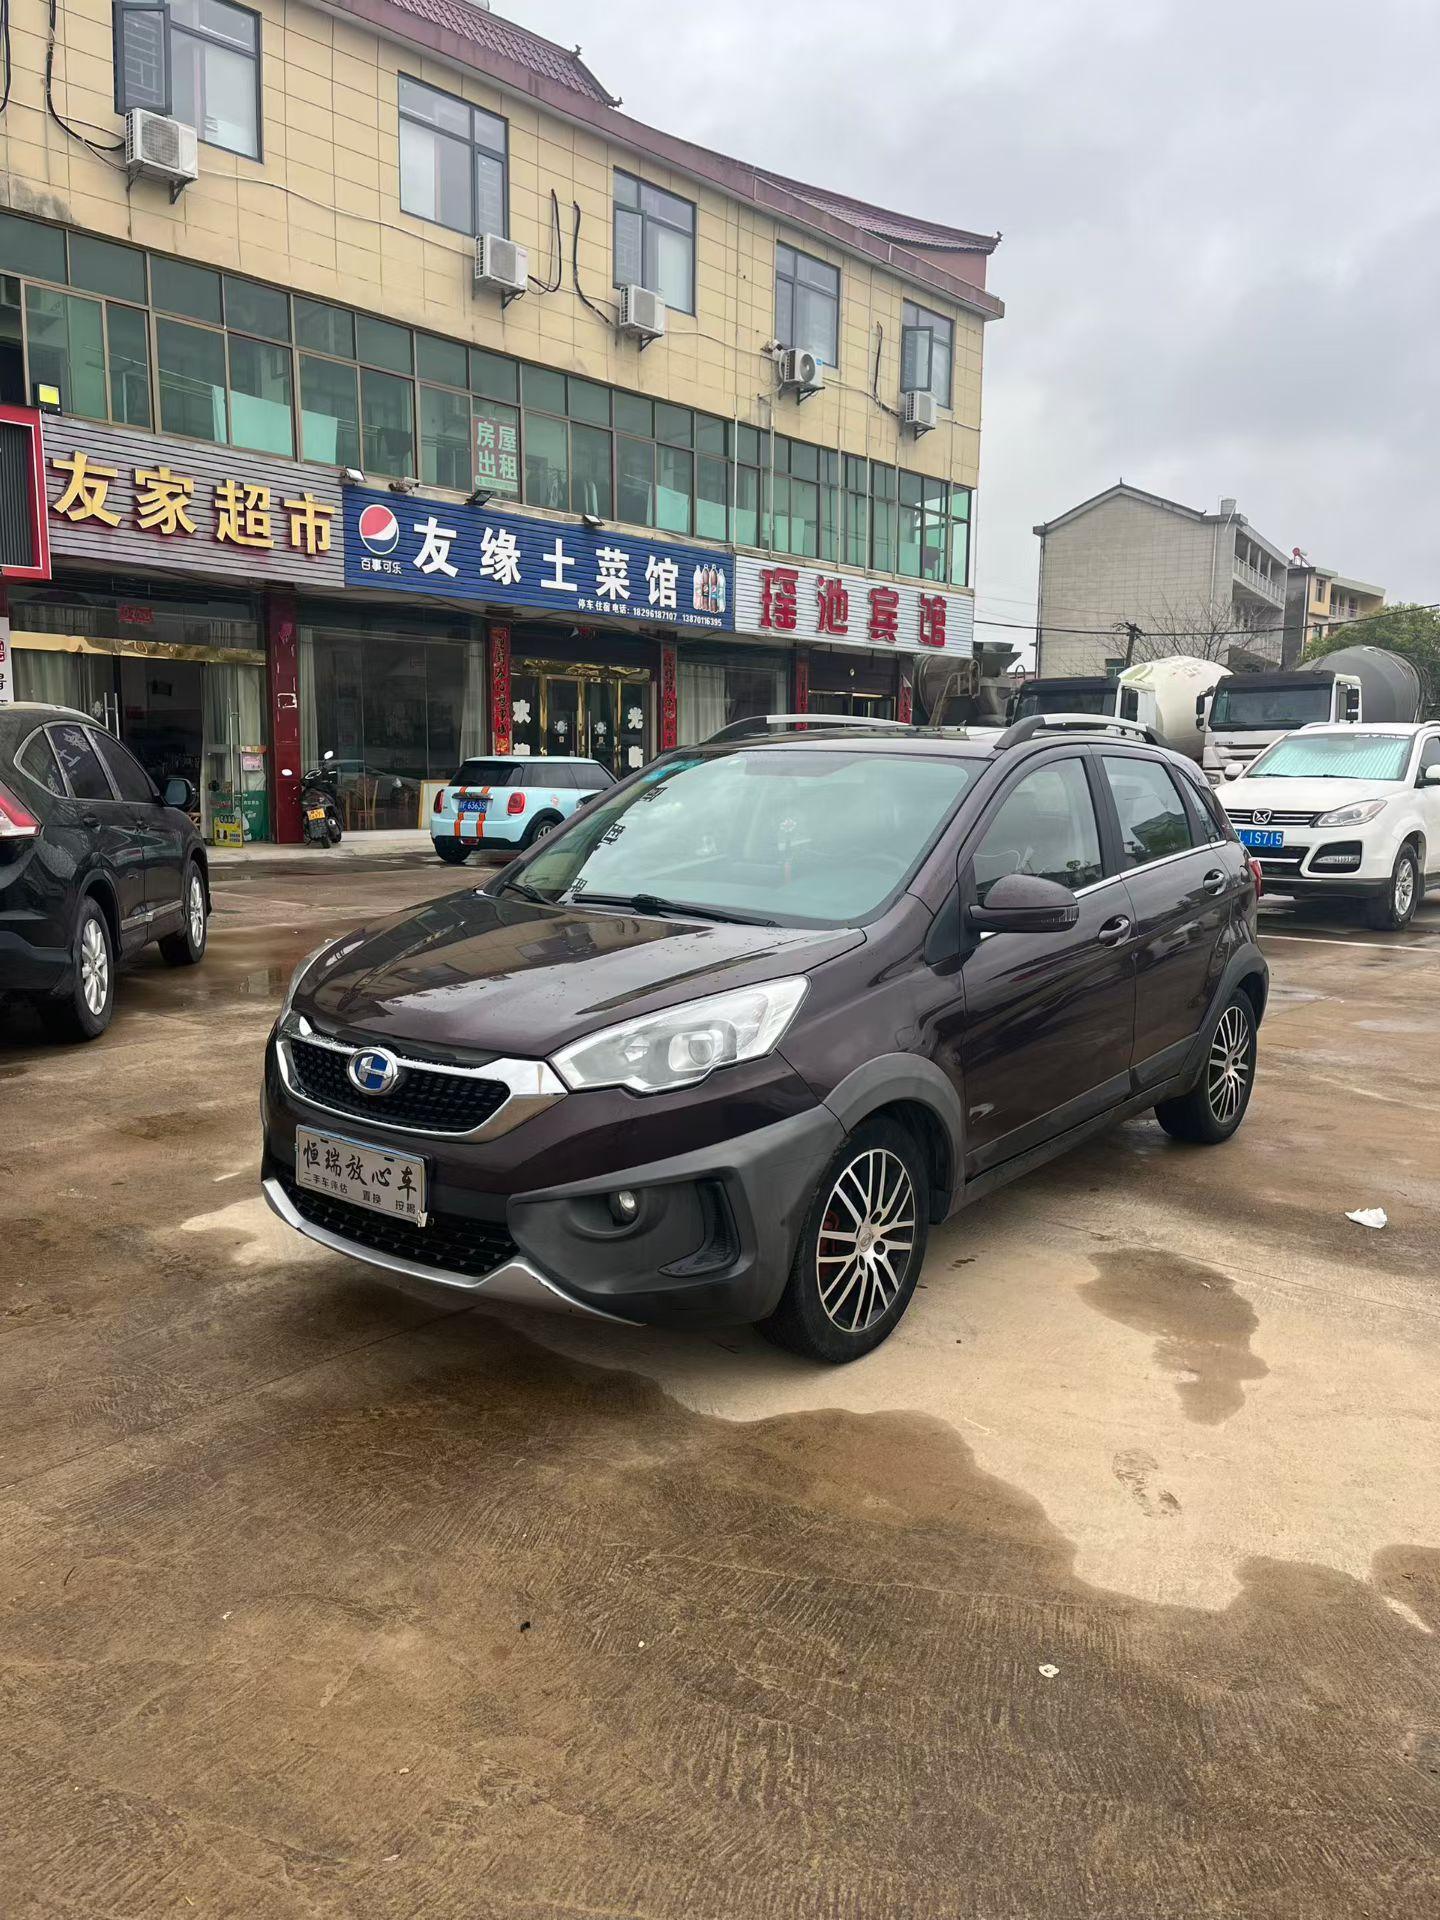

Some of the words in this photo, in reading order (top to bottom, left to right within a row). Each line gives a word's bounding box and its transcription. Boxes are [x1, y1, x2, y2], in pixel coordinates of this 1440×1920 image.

[477, 421, 517, 453] 房屋
[479, 450, 518, 480] 出租
[52, 450, 335, 555] 友家超市
[361, 557, 402, 574] 百事可乐
[413, 516, 678, 608] 友缘土菜馆
[633, 607, 677, 620] 18296187107
[682, 614, 722, 626] 13870116395
[759, 567, 947, 648] 瑶池宾馆
[303, 1140, 417, 1201] 恒瑞放心车
[304, 1171, 348, 1194] 二手车评估
[362, 1189, 382, 1205] 置换
[395, 1199, 416, 1215] 按揭
